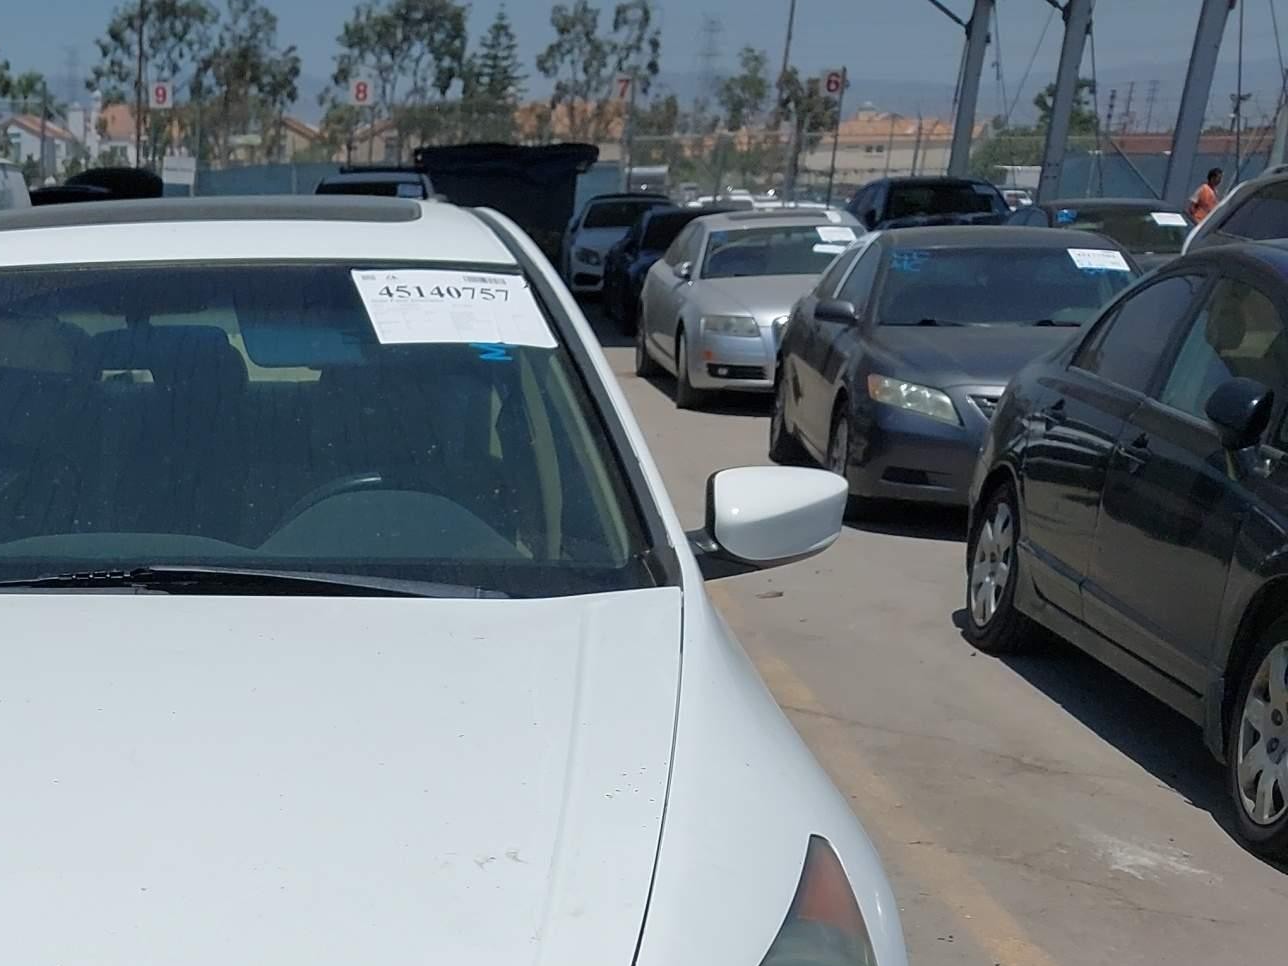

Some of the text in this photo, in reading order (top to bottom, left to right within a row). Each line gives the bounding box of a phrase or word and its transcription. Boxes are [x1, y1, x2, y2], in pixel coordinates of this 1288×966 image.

[355, 81, 367, 101] 8
[618, 79, 629, 96] 7
[826, 72, 840, 92] 6
[155, 85, 167, 104] 9
[378, 285, 510, 302] 45140757
